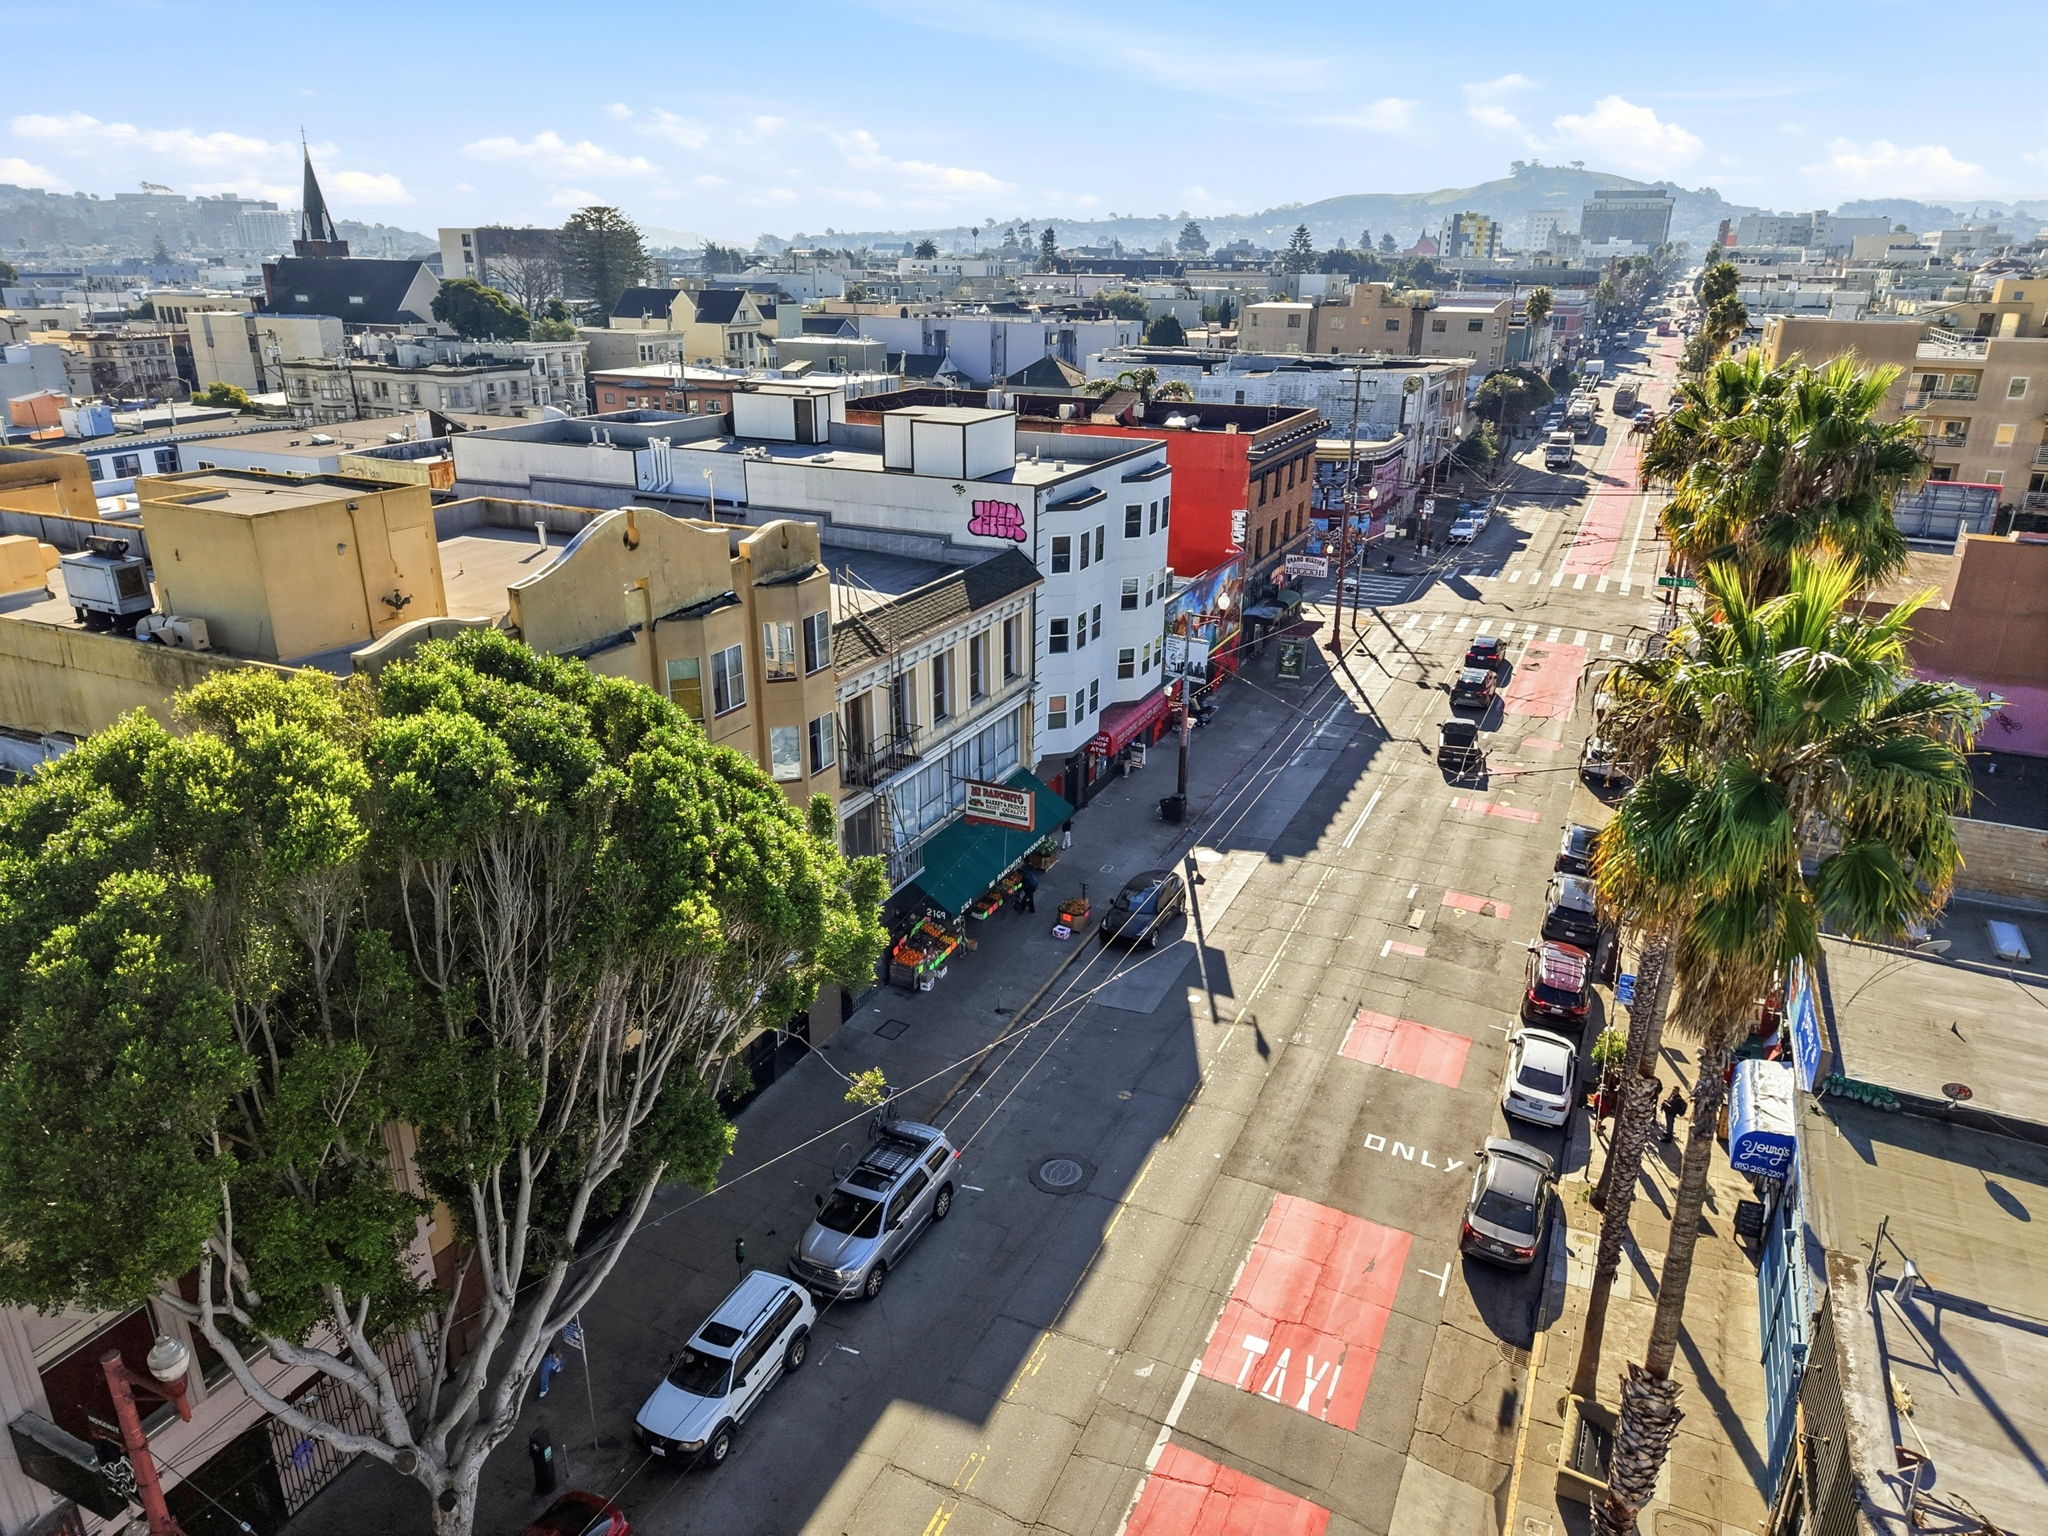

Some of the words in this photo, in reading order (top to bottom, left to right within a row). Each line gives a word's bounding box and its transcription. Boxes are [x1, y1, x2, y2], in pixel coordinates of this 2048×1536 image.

[971, 786, 982, 796] MI
[982, 787, 1024, 805] RANCHITO
[997, 856, 1022, 881] RANCHITO
[926, 908, 946, 920] 2169
[1363, 1133, 1464, 1173] ONLY
[1740, 1140, 1790, 1165] Young's
[1235, 1334, 1345, 1421] TAXI
